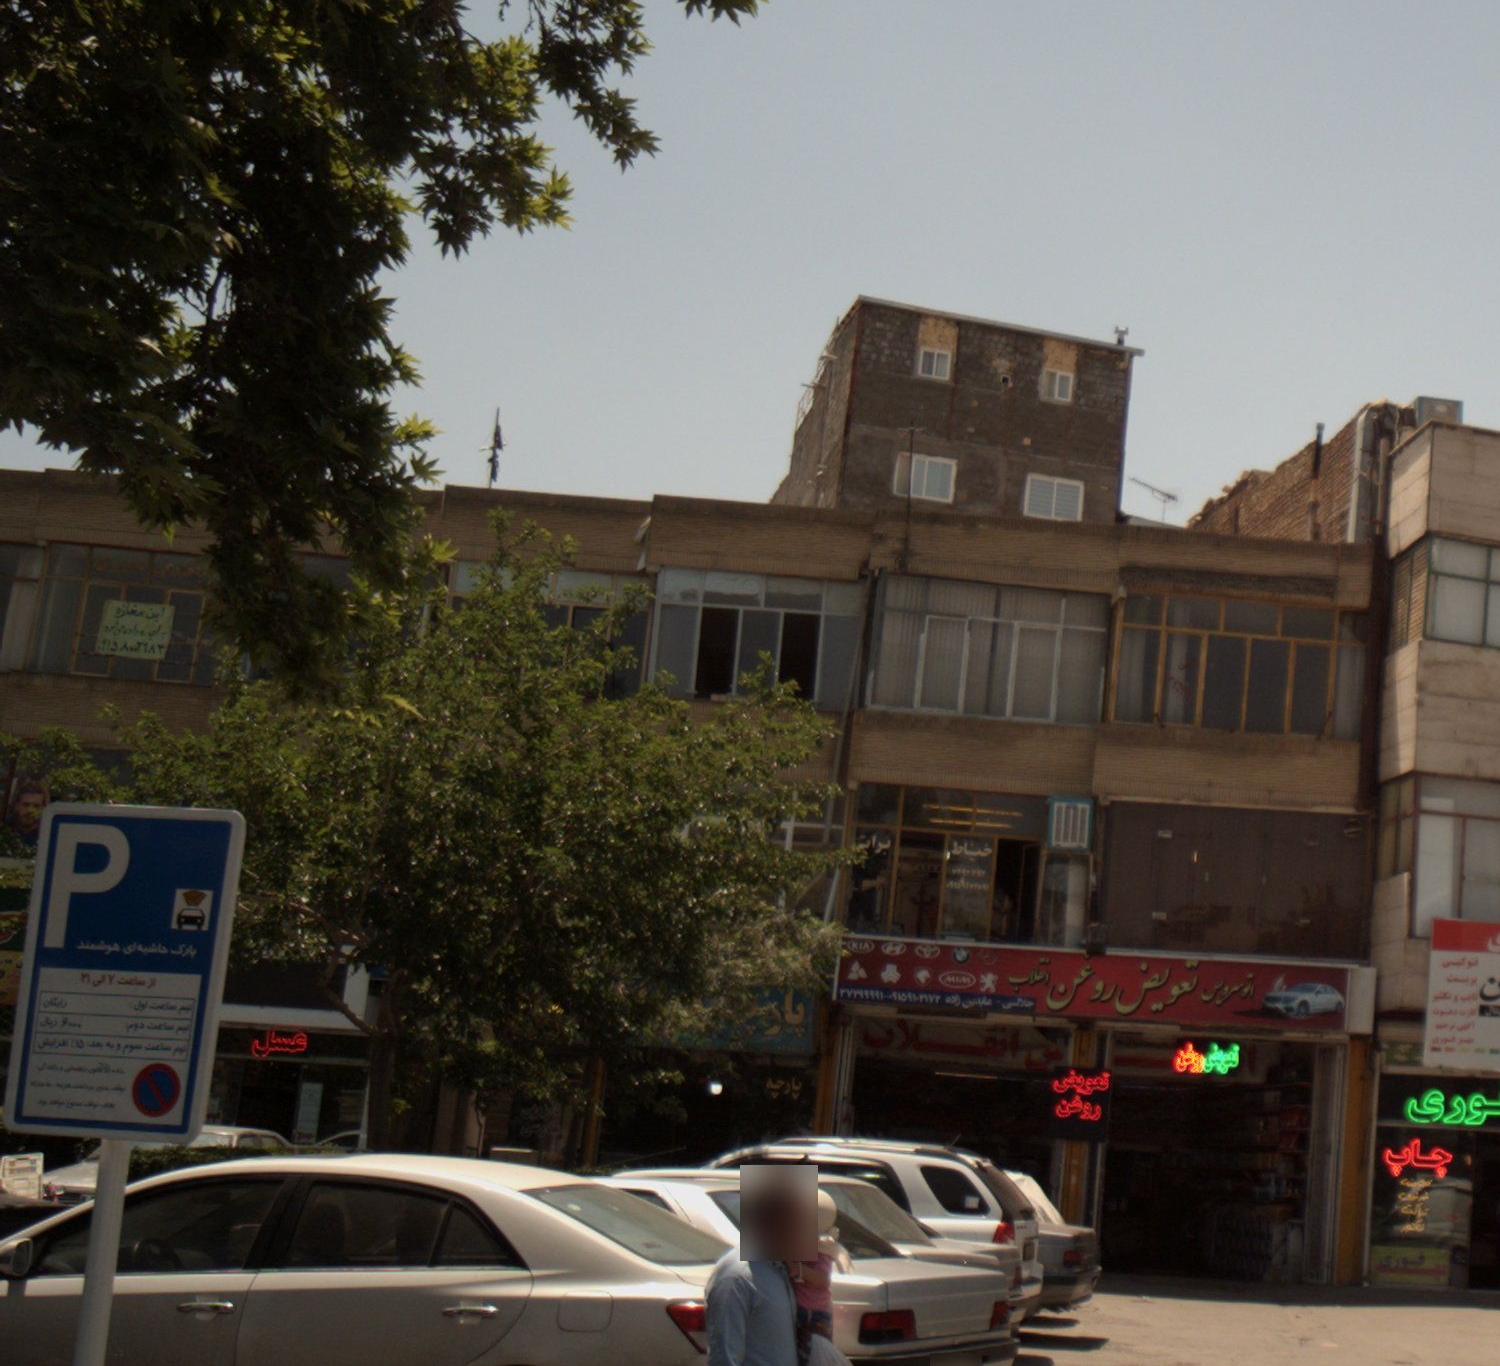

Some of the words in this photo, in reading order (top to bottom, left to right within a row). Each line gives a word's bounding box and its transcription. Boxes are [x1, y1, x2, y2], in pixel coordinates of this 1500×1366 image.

[44, 822, 130, 948] P
[76, 939, 121, 954] هوشمند
[1046, 953, 1117, 1011] روغن
[1113, 958, 1198, 1014] تعویض
[1053, 1069, 1110, 1095] تعویض
[1056, 1094, 1101, 1121] روغن
[1383, 1138, 1453, 1179] چاپ
